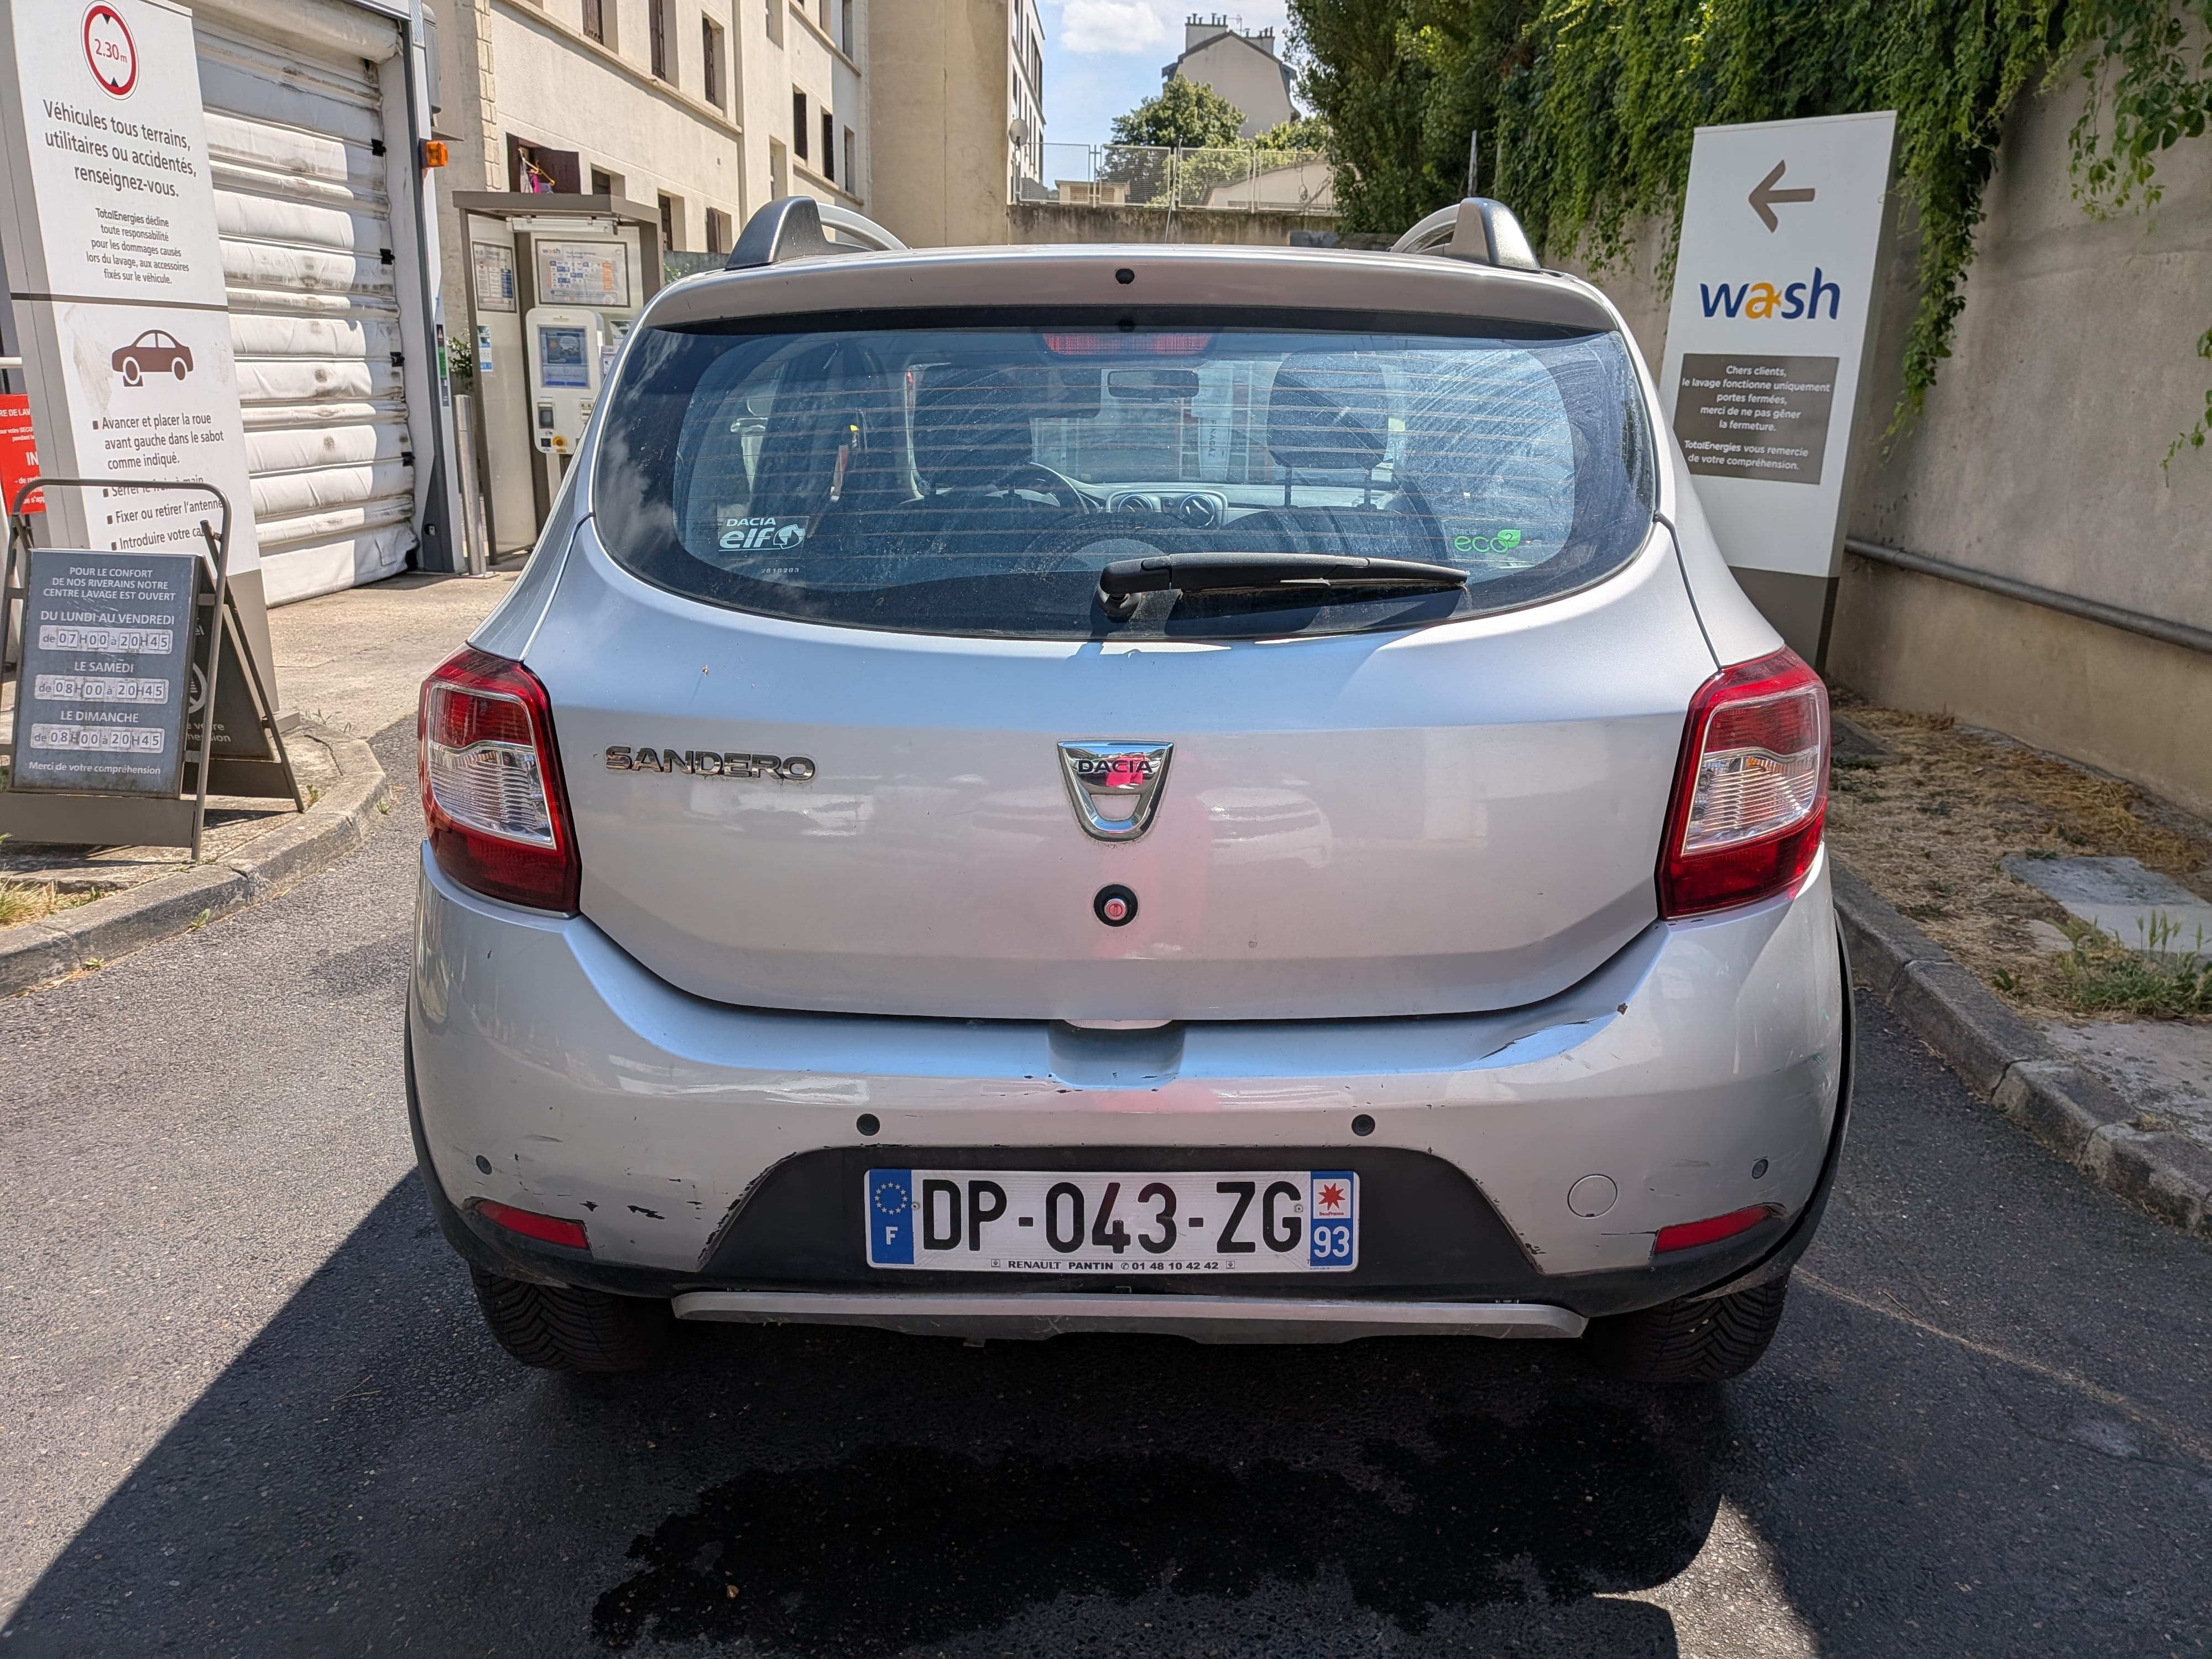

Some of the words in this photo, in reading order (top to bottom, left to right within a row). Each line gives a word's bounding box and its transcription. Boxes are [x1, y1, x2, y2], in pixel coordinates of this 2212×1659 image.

[43, 99, 108, 131] Véhicules
[110, 117, 139, 138] tous
[140, 124, 191, 151] terrains,
[45, 130, 108, 158] utilitaires
[112, 147, 129, 162] ou
[132, 150, 196, 178] accidentés,
[74, 165, 179, 197] renseignez-vous.
[95, 207, 144, 225] TotalEnergies
[145, 215, 169, 228] décline
[101, 224, 120, 236] toute
[122, 228, 169, 242] responsabilité
[91, 239, 108, 250] pour
[109, 238, 120, 251] les
[121, 241, 159, 257] dommages
[160, 247, 182, 257] causés
[86, 251, 101, 263] lors
[102, 253, 111, 264] du
[112, 254, 138, 268] lavage,
[139, 259, 152, 269] aux
[153, 260, 189, 272] accessoires
[103, 268, 121, 280] fixés
[122, 272, 133, 281] sur
[134, 271, 142, 281] le
[142, 273, 173, 284] véhicule.
[1699, 266, 1840, 320] wash
[1725, 365, 1752, 375] Chers
[1754, 367, 1787, 378] clients,
[1682, 378, 1690, 387] le
[1692, 378, 1721, 389] lavage
[1723, 379, 1772, 390] fonctionne
[1773, 382, 1831, 393] uniquement
[1716, 393, 1746, 403] portes
[1747, 393, 1788, 406] fermées,
[1700, 406, 1726, 415] merci
[1727, 406, 1739, 416] de
[1754, 410, 1771, 419] pas
[102, 416, 139, 430] Avancer
[142, 415, 152, 428] et
[153, 414, 180, 430] placer
[181, 413, 190, 425] la
[192, 414, 211, 425] roue
[1719, 419, 1727, 429] la
[1729, 420, 1777, 432] fermeture.
[105, 436, 133, 450] avant
[134, 433, 166, 451] gauche
[168, 432, 189, 445] dans
[190, 430, 199, 443] le
[201, 429, 225, 442] sabot
[1684, 440, 1741, 453] TotalEnergies
[1767, 448, 1809, 457] remercie
[107, 457, 142, 470] comme
[143, 451, 180, 468] indiqué.
[1688, 453, 1699, 462] de
[1701, 455, 1725, 465] votre
[1726, 458, 1799, 471] compréhension.
[115, 508, 138, 524] Fixer
[141, 509, 153, 520] ou
[155, 503, 182, 518] retirer
[726, 518, 776, 527] DACIA
[119, 531, 165, 550] Introduire
[167, 526, 190, 542] votre
[719, 527, 775, 549] elf
[70, 567, 95, 576] POUR
[109, 568, 153, 578] CONFORT
[53, 578, 65, 586] DE
[66, 578, 86, 587] NOS
[88, 579, 135, 589] RIVERAINS
[137, 581, 169, 590] NOTRE
[43, 588, 79, 598] CENTRE
[81, 589, 118, 599] LAVAGE
[138, 592, 176, 602] OUVERT
[40, 611, 58, 621] DU
[61, 612, 96, 623] LUNDI
[98, 613, 116, 624] AU
[118, 614, 175, 625] VENDREDI
[43, 634, 56, 643] de
[111, 637, 117, 646] à
[74, 661, 87, 671] LE
[88, 662, 134, 674] SAMEDI
[39, 684, 52, 692] de
[106, 686, 113, 696] à
[60, 711, 73, 721] LE
[76, 712, 139, 723] DIMANCHE
[34, 733, 47, 742] de
[102, 735, 108, 745] à
[28, 761, 54, 770] Merci
[69, 764, 93, 773] votre
[94, 764, 161, 775] compréhension
[606, 745, 816, 781] SANDERO
[1078, 760, 1154, 774] DACIA
[885, 1226, 898, 1245] F
[922, 1179, 1302, 1254] DP-043-ZG
[1314, 1226, 1350, 1258] 93
[1008, 1260, 1061, 1270] RENAULT
[1068, 1261, 1113, 1270] PANTIN
[1131, 1262, 1145, 1270] 01
[1149, 1262, 1165, 1270] 48
[1168, 1262, 1182, 1270] 10
[1186, 1262, 1201, 1270] 42
[1203, 1261, 1219, 1270] 42
